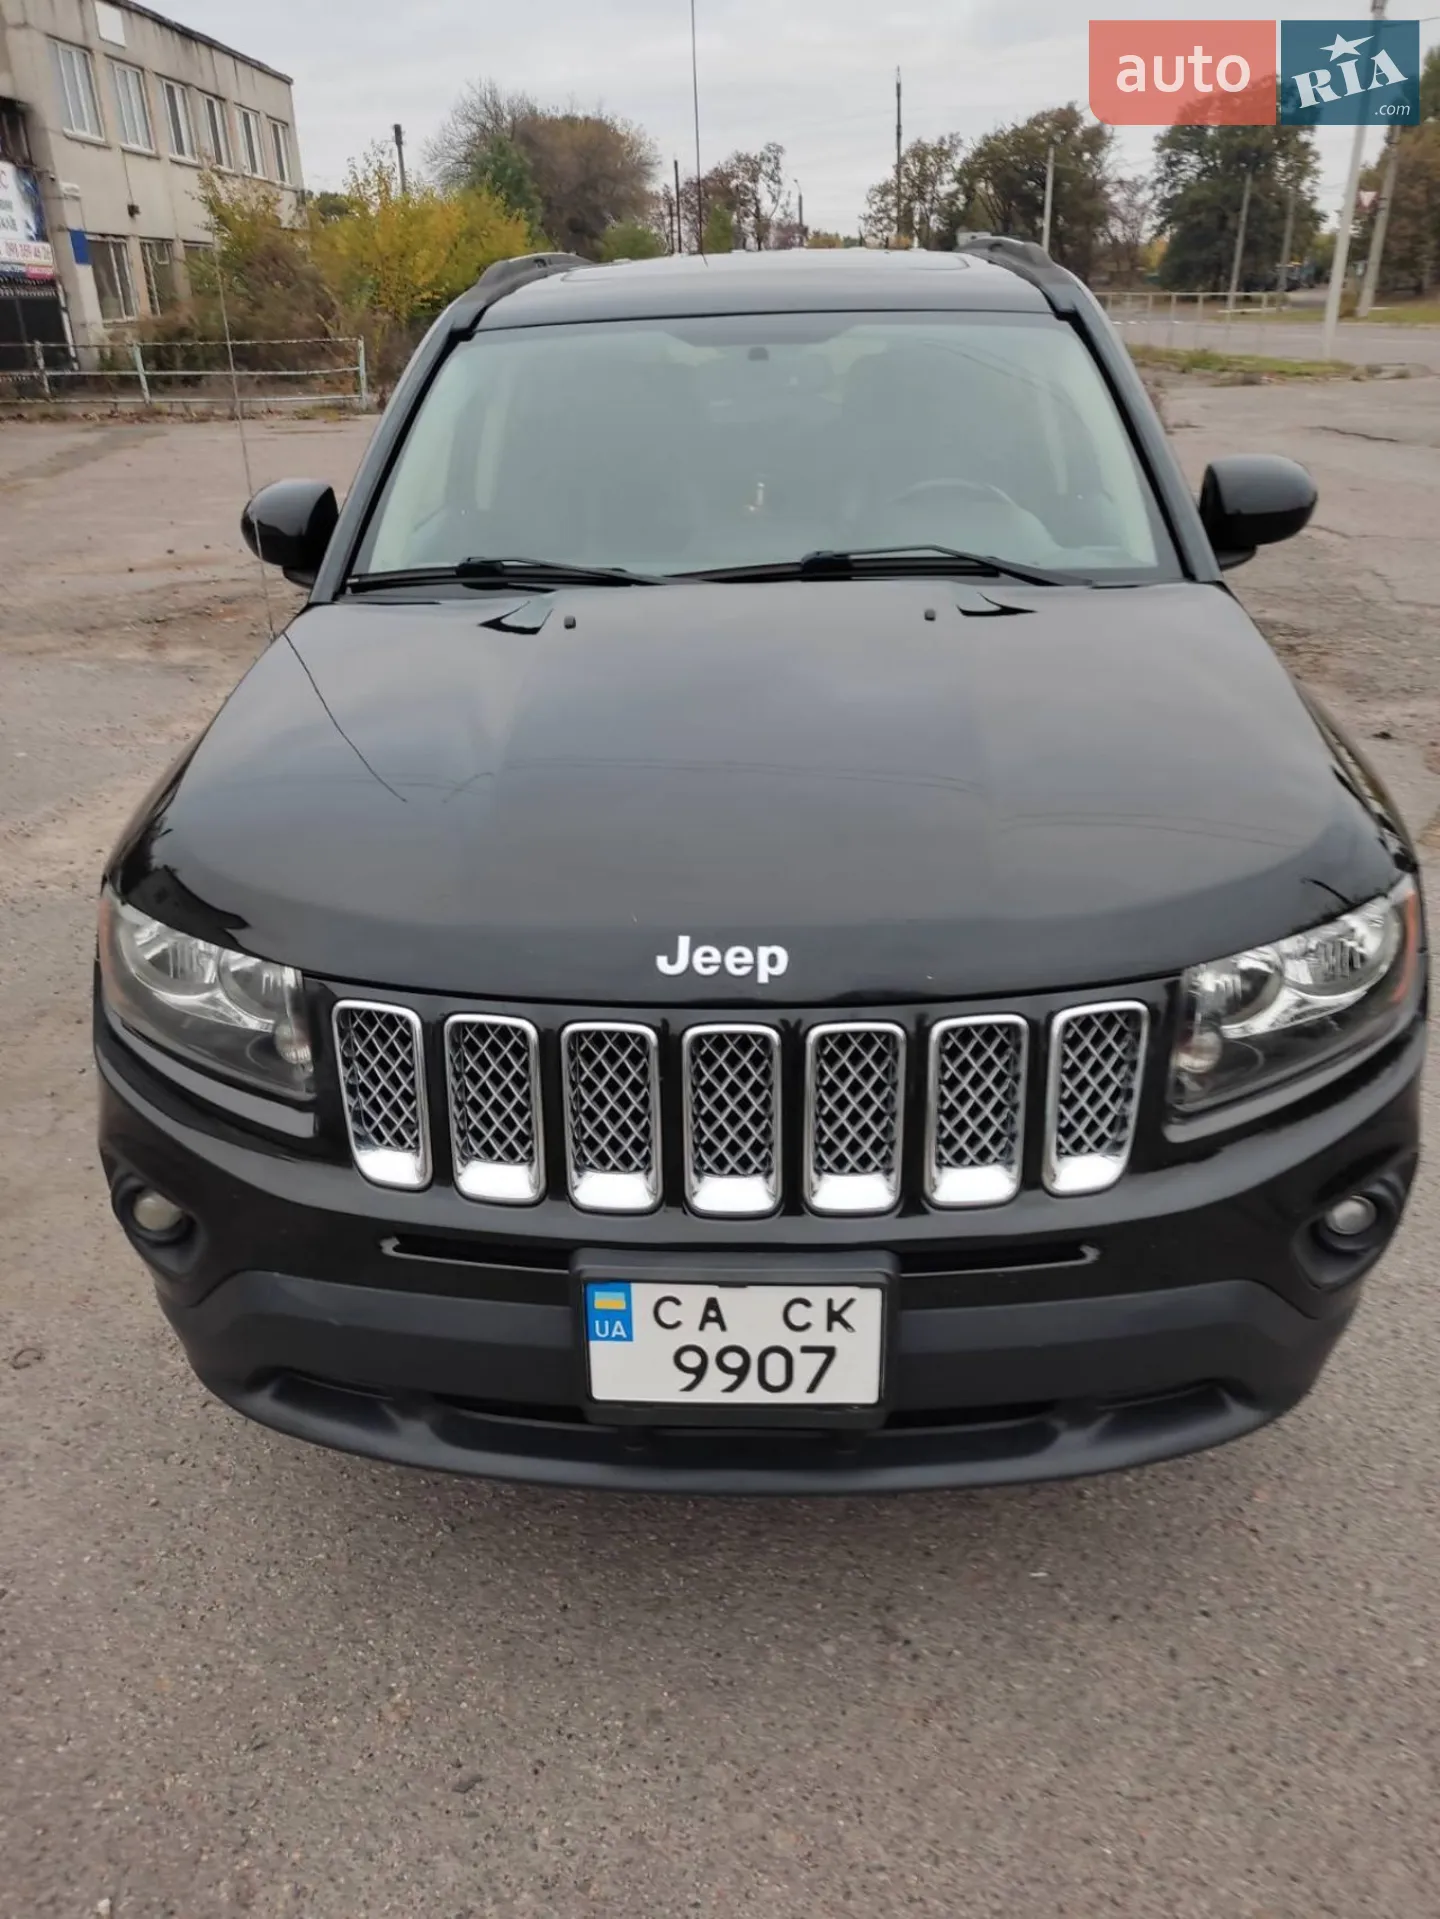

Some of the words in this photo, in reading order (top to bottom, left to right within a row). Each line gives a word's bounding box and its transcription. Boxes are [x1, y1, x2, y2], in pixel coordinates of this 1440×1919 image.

[655, 934, 789, 984] Jeep
[594, 1319, 628, 1339] UA
[652, 1295, 728, 1332] CA
[782, 1297, 857, 1333] CK
[673, 1344, 837, 1394] 9907
